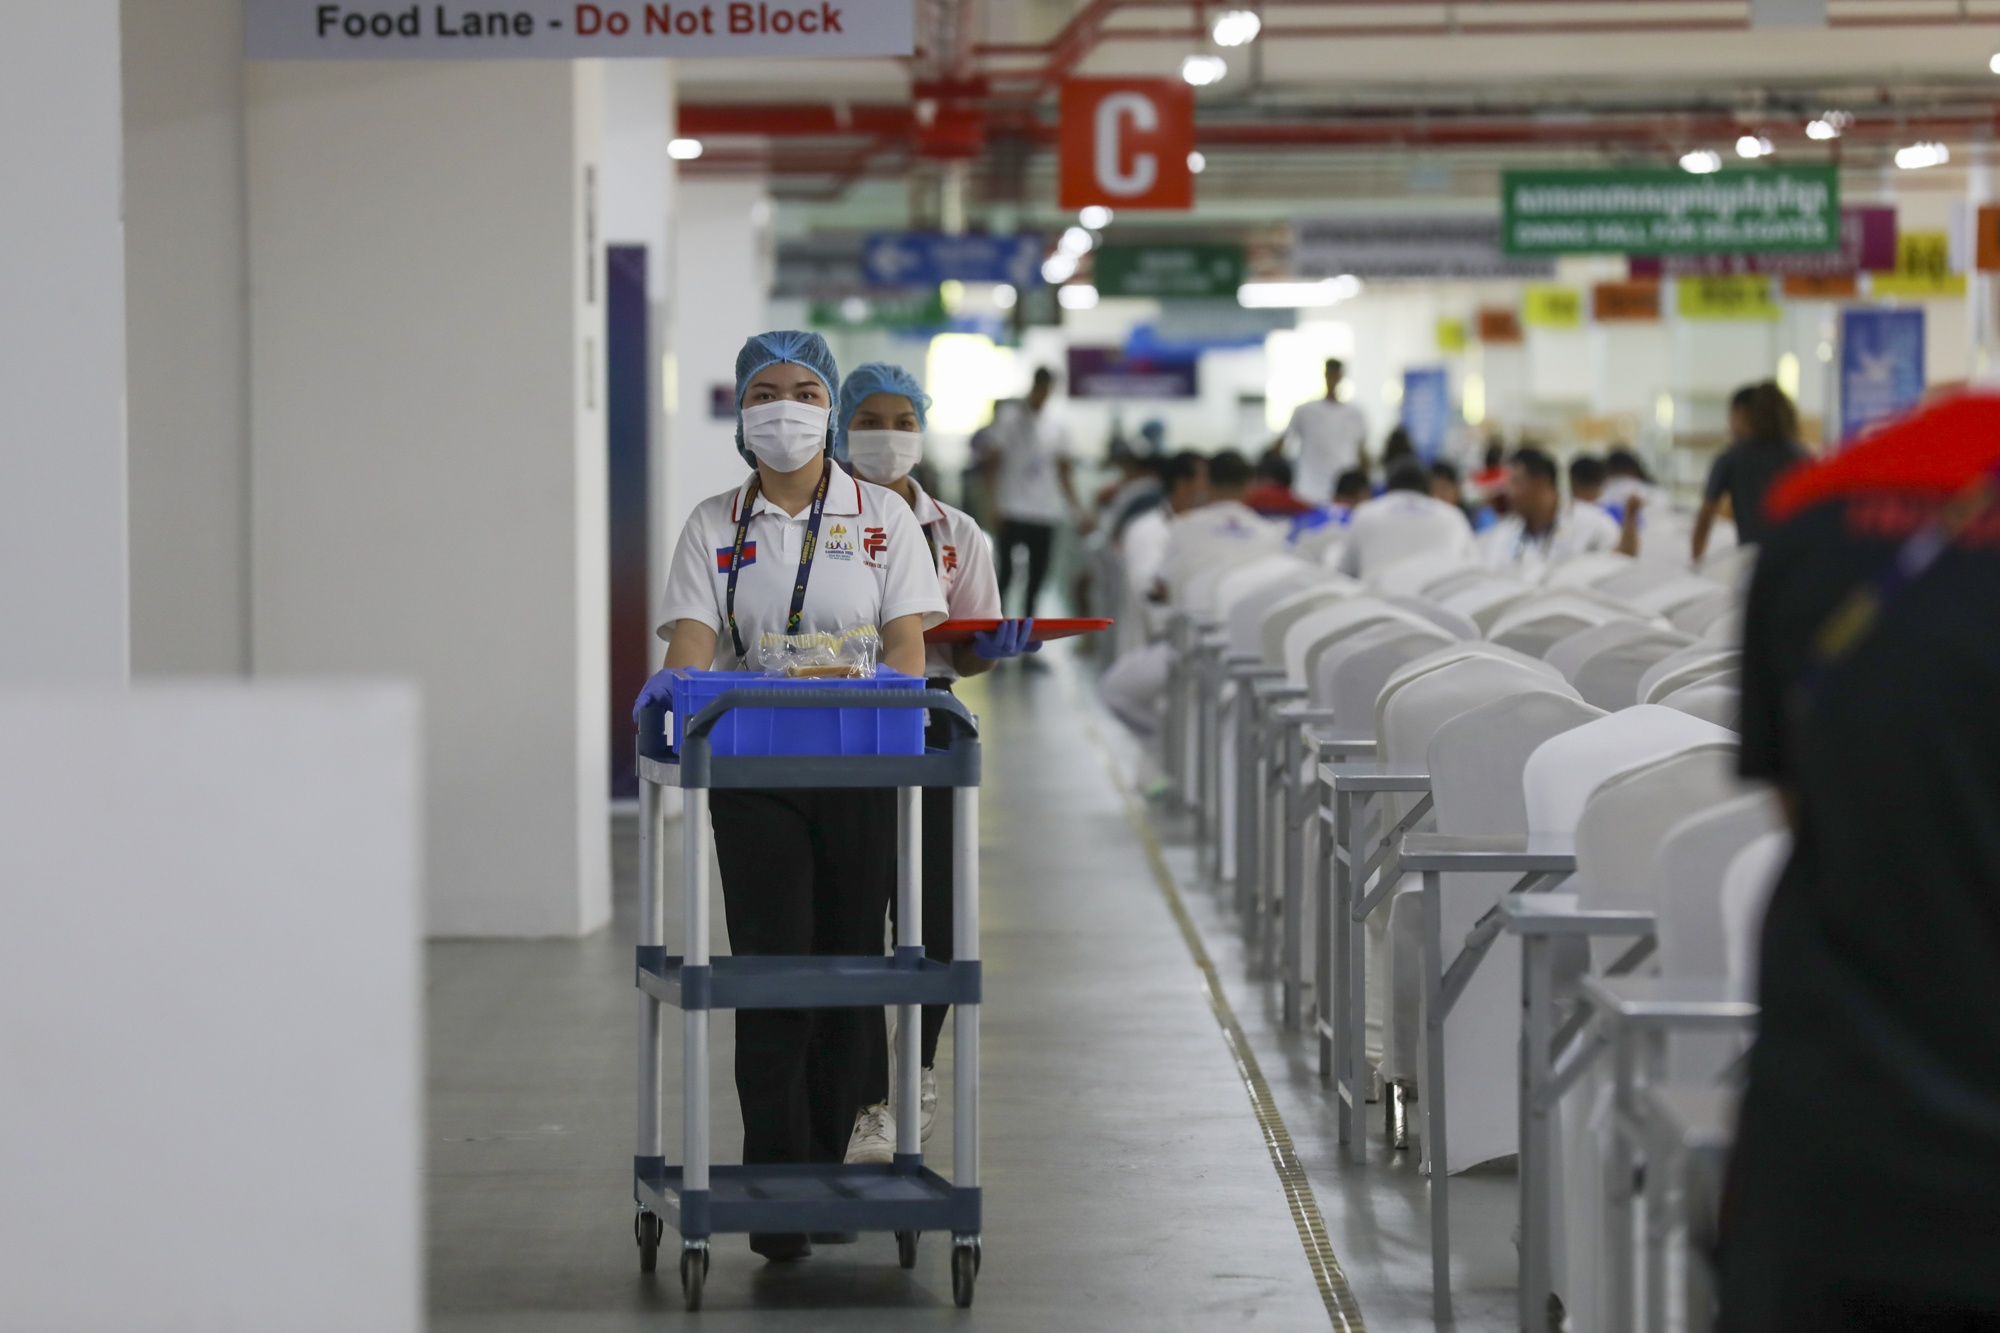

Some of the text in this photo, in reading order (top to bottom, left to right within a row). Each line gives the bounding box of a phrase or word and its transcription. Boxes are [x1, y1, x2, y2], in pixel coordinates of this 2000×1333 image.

[316, 4, 421, 37] Food
[434, 5, 534, 36] Lane
[575, 3, 631, 35] Do
[644, 3, 713, 34] Not
[728, 2, 843, 33] Block
[1095, 92, 1158, 197] C
[1653, 221, 1697, 243] FOR
